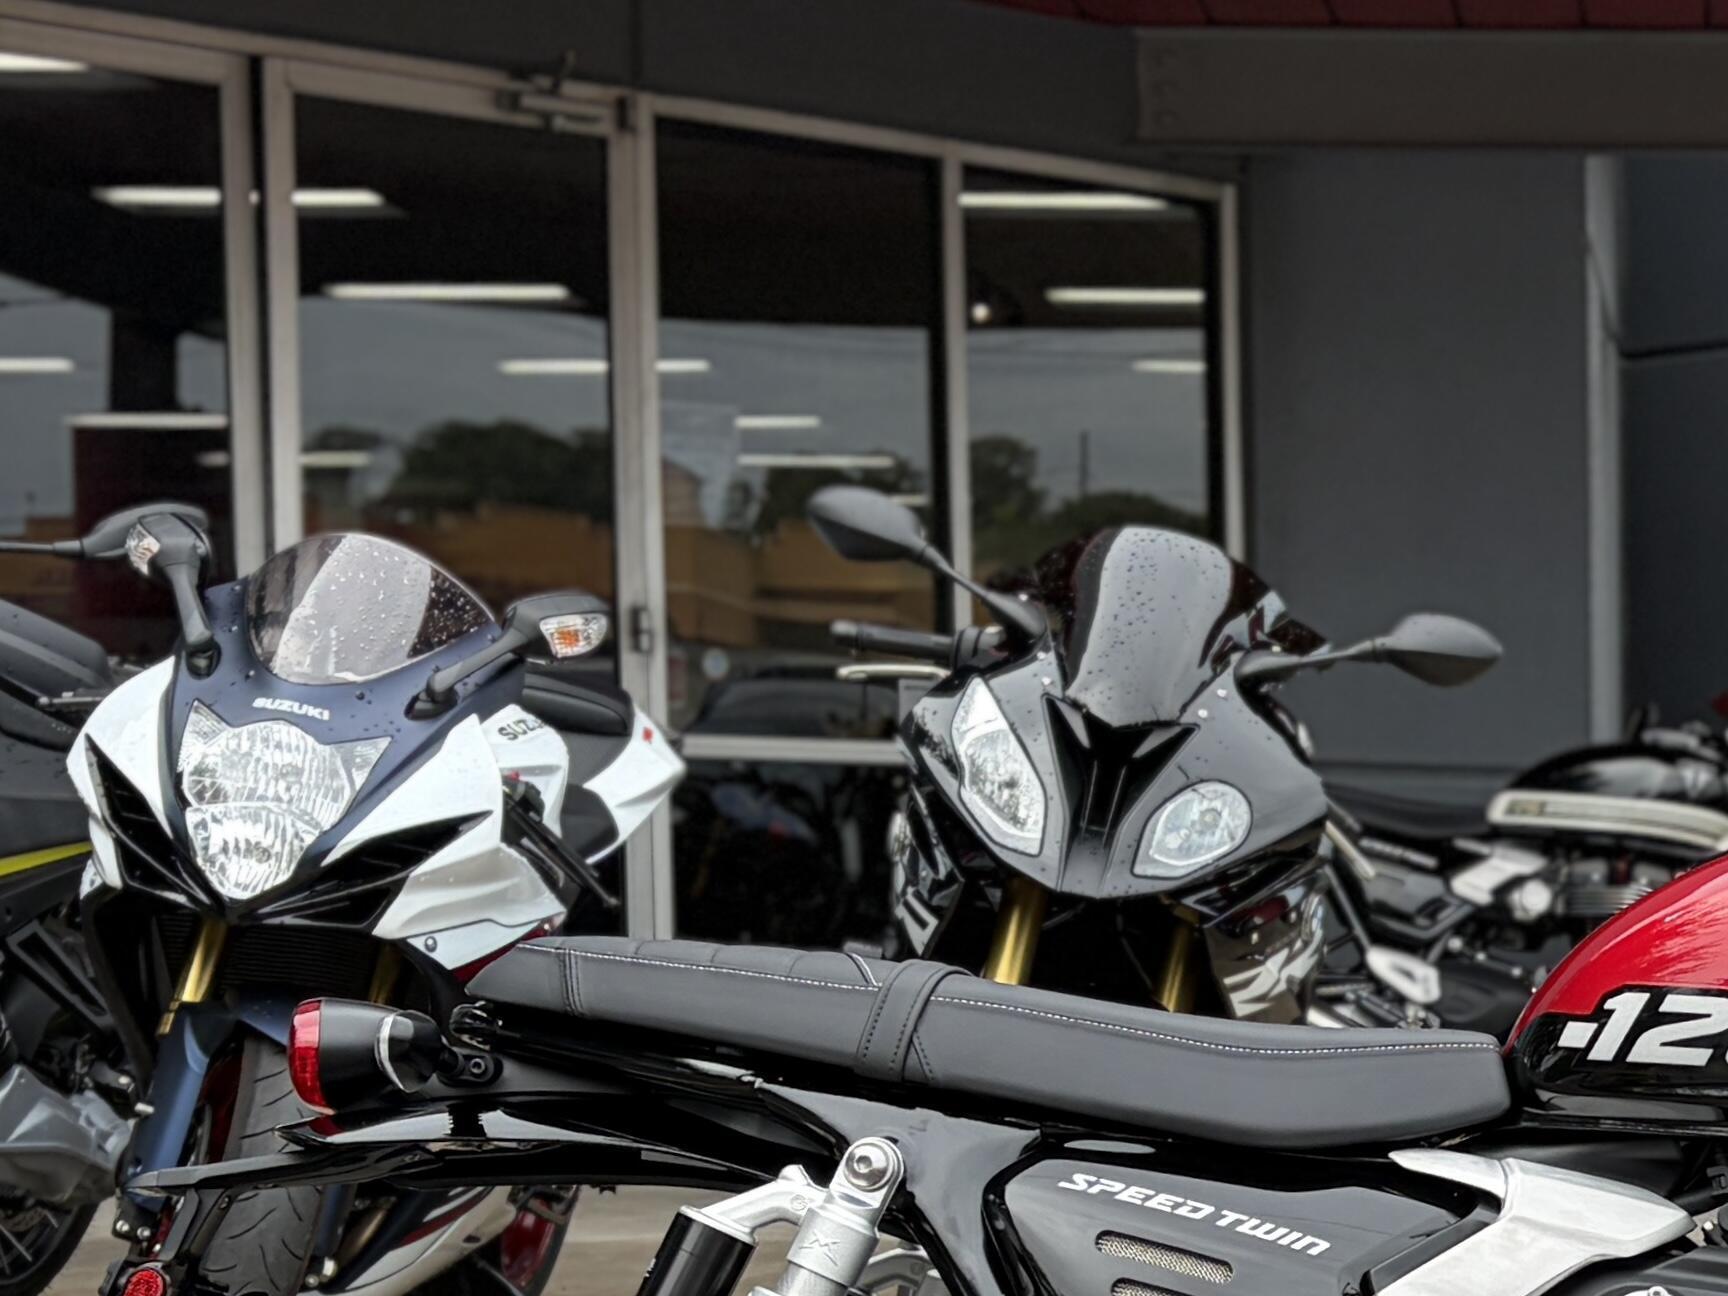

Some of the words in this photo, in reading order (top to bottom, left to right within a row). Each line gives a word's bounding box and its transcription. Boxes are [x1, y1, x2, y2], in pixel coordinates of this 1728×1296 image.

[252, 697, 330, 720] SUZUKI
[1057, 1172, 1216, 1220] SPEED
[1215, 1209, 1332, 1256] TWIN
